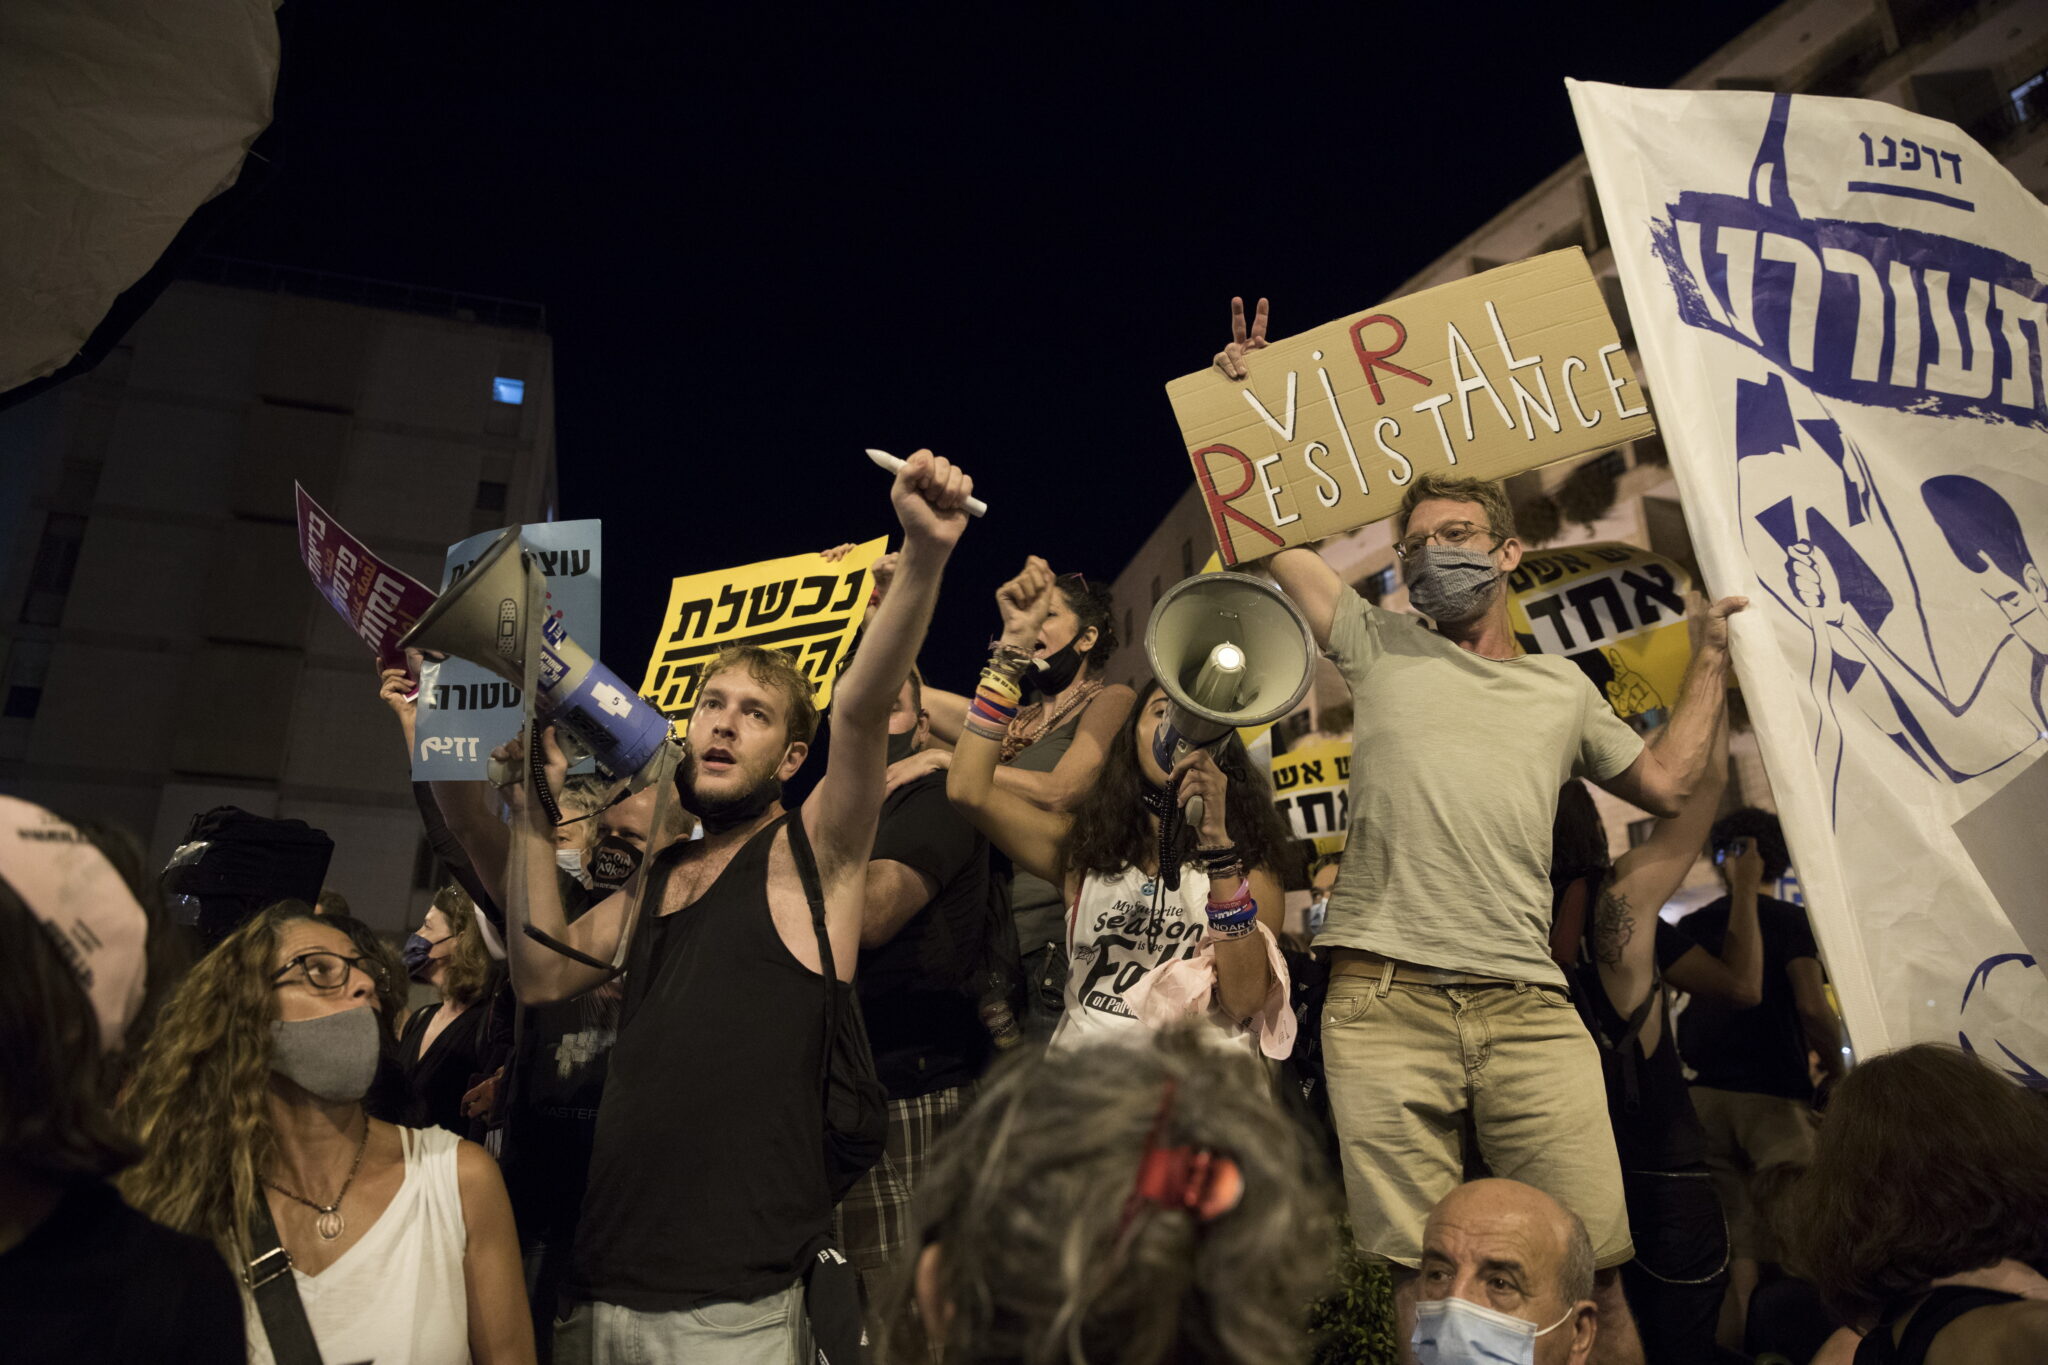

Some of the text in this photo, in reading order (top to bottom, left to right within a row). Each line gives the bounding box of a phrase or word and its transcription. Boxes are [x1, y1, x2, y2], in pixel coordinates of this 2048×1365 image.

[1191, 334, 1648, 566] RESISTANCE
[359, 571, 407, 653] תקווה
[669, 568, 867, 643] נכשלת
[1525, 563, 1686, 651] אחד
[611, 696, 620, 706] 5
[1112, 899, 1135, 916] My
[1093, 912, 1204, 943] season
[1136, 940, 1146, 950] is
[1092, 995, 1107, 1008] of
